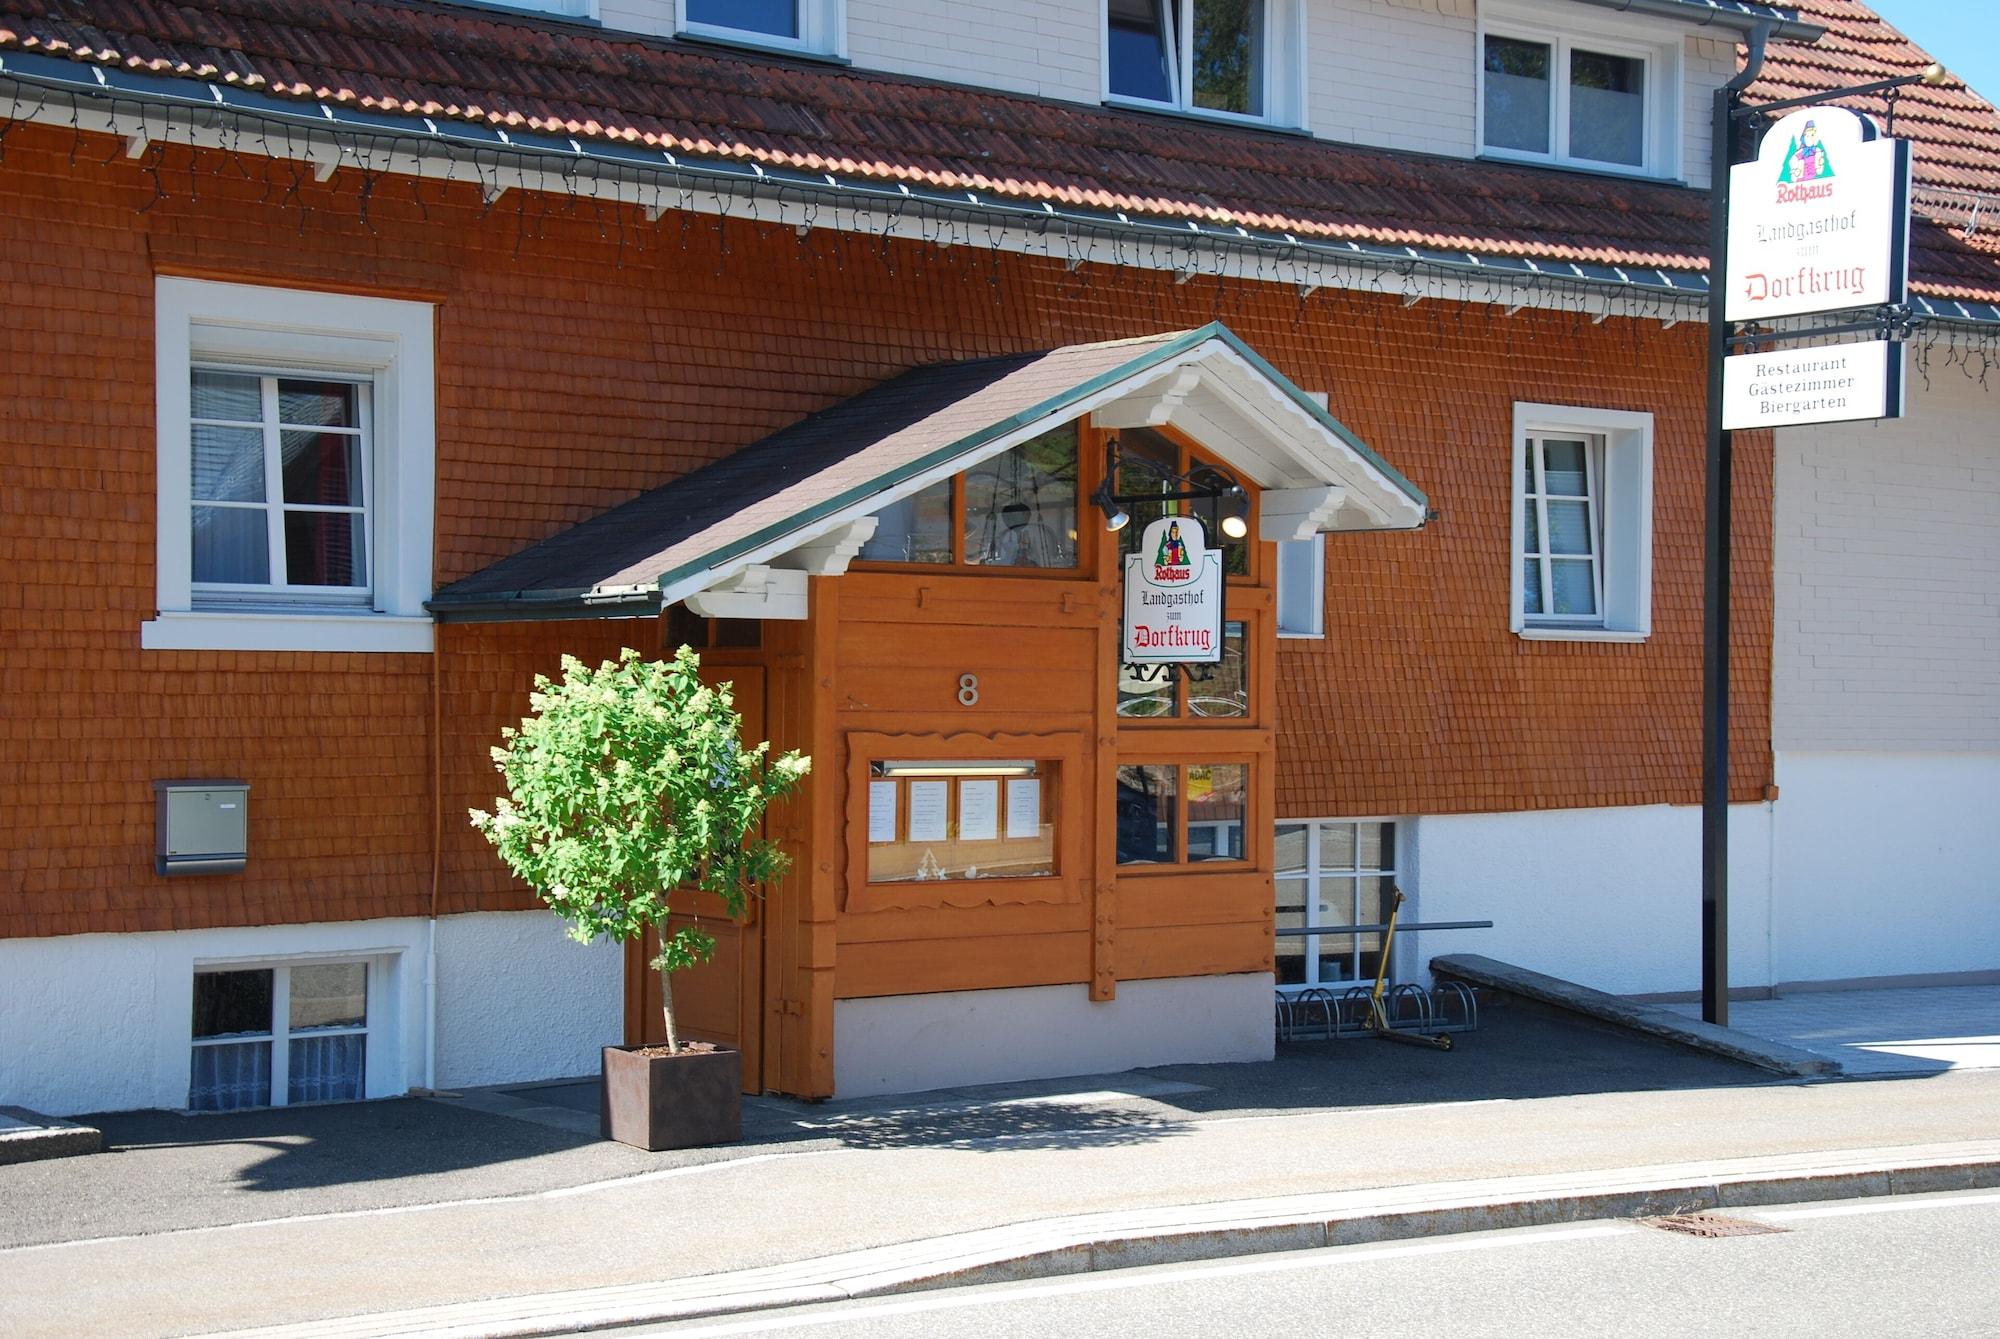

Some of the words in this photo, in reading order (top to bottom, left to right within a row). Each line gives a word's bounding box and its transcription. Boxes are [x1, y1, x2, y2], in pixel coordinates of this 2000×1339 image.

[1776, 182, 1833, 204] Rothaus
[1757, 210, 1856, 242] Landgasthof
[1745, 267, 1865, 301] Dorfkrug
[1756, 357, 1846, 377] Restaurant
[1760, 397, 1846, 414] Biergarten
[1154, 565, 1190, 583] Rothaus
[1142, 590, 1204, 607] Landgasthof
[1166, 611, 1182, 622] zum
[1134, 624, 1211, 650] Dorfkrug
[958, 673, 979, 706] 8
[1189, 769, 1211, 780] ADAC
